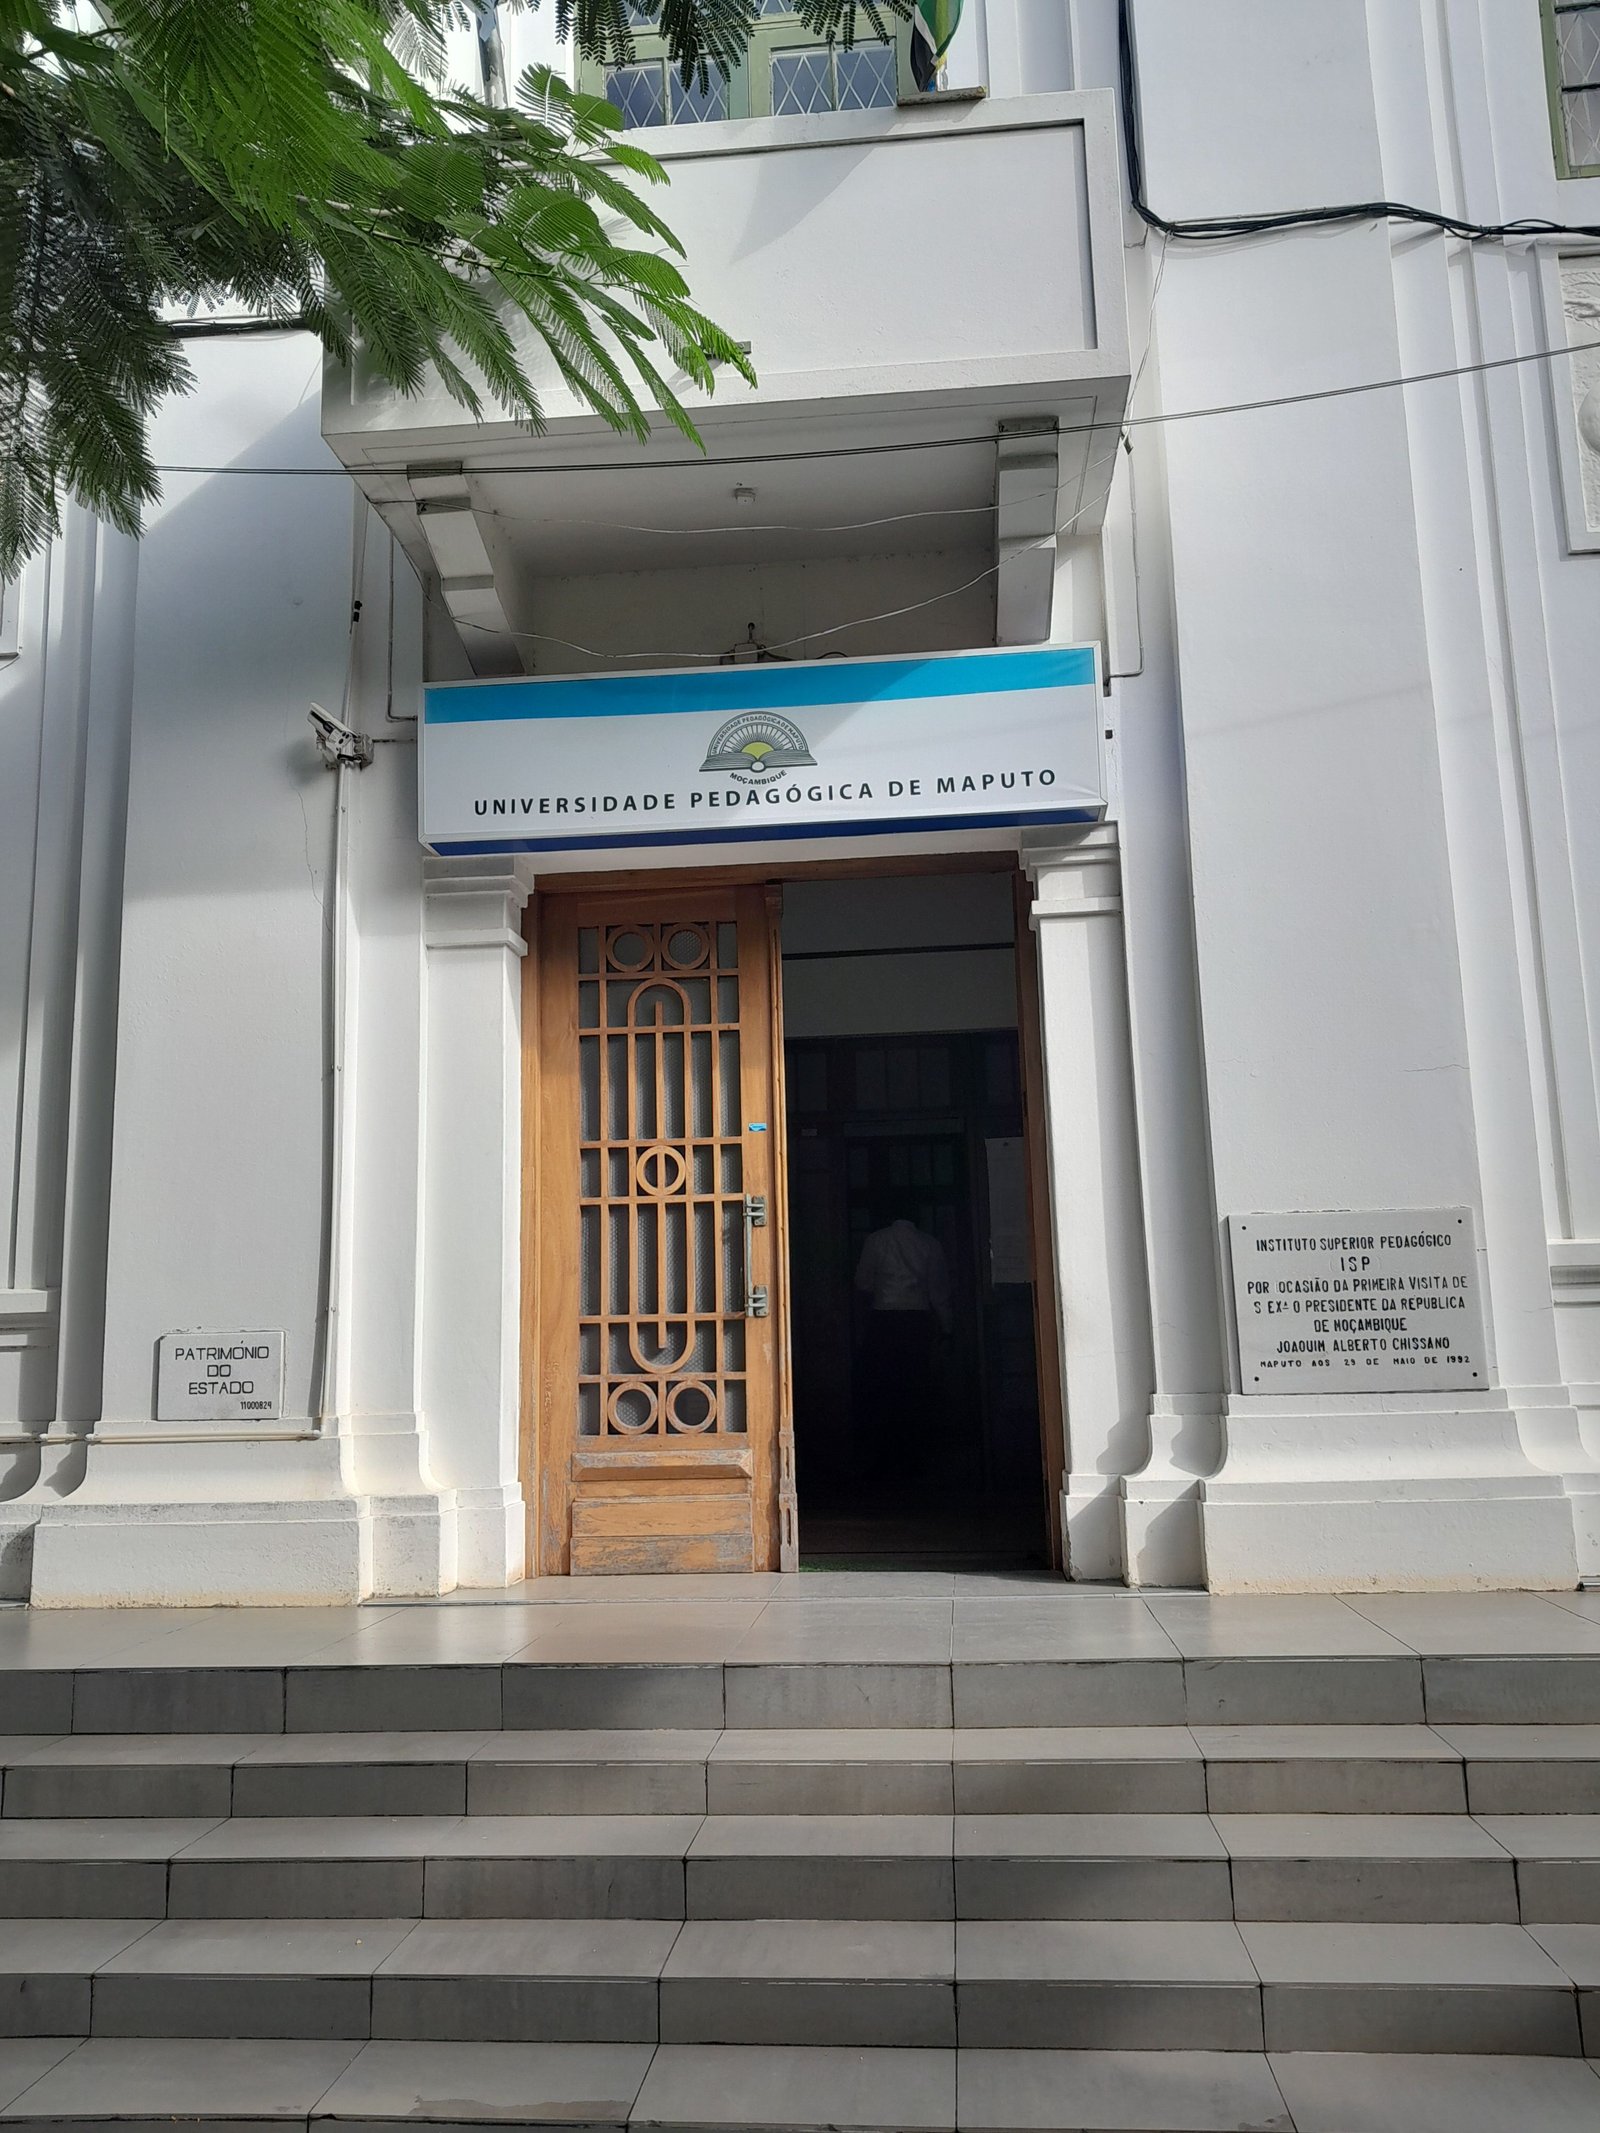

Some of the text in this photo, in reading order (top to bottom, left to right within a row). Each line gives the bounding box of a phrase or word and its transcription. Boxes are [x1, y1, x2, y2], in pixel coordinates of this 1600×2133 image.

[730, 770, 787, 785] MOÇAMBIQUE
[474, 768, 1058, 816] UNIVERSIDADE PEDAGÓGICA DE MAPUTO
[1256, 1231, 1451, 1251] INSTITUTO SUPERIOR PEDAGÓGICO
[1247, 1276, 1468, 1294] POR OCASIÃO DA PRIMEIRA VISITA DE
[1293, 1301, 1300, 1313] O
[1305, 1298, 1377, 1312] PRESIDENTE
[1382, 1298, 1396, 1311] DA
[1401, 1296, 1465, 1310] REPUBLICA
[1314, 1317, 1407, 1333] DE MOÇAMBIQUE
[175, 1340, 269, 1360] PATRIMÓNIO
[1333, 1338, 1387, 1352] ALBERTO
[1392, 1336, 1450, 1350] CHISSANO
[1424, 1356, 1438, 1364] DE
[207, 1364, 231, 1377] DO
[189, 1381, 254, 1395] ESTADO
